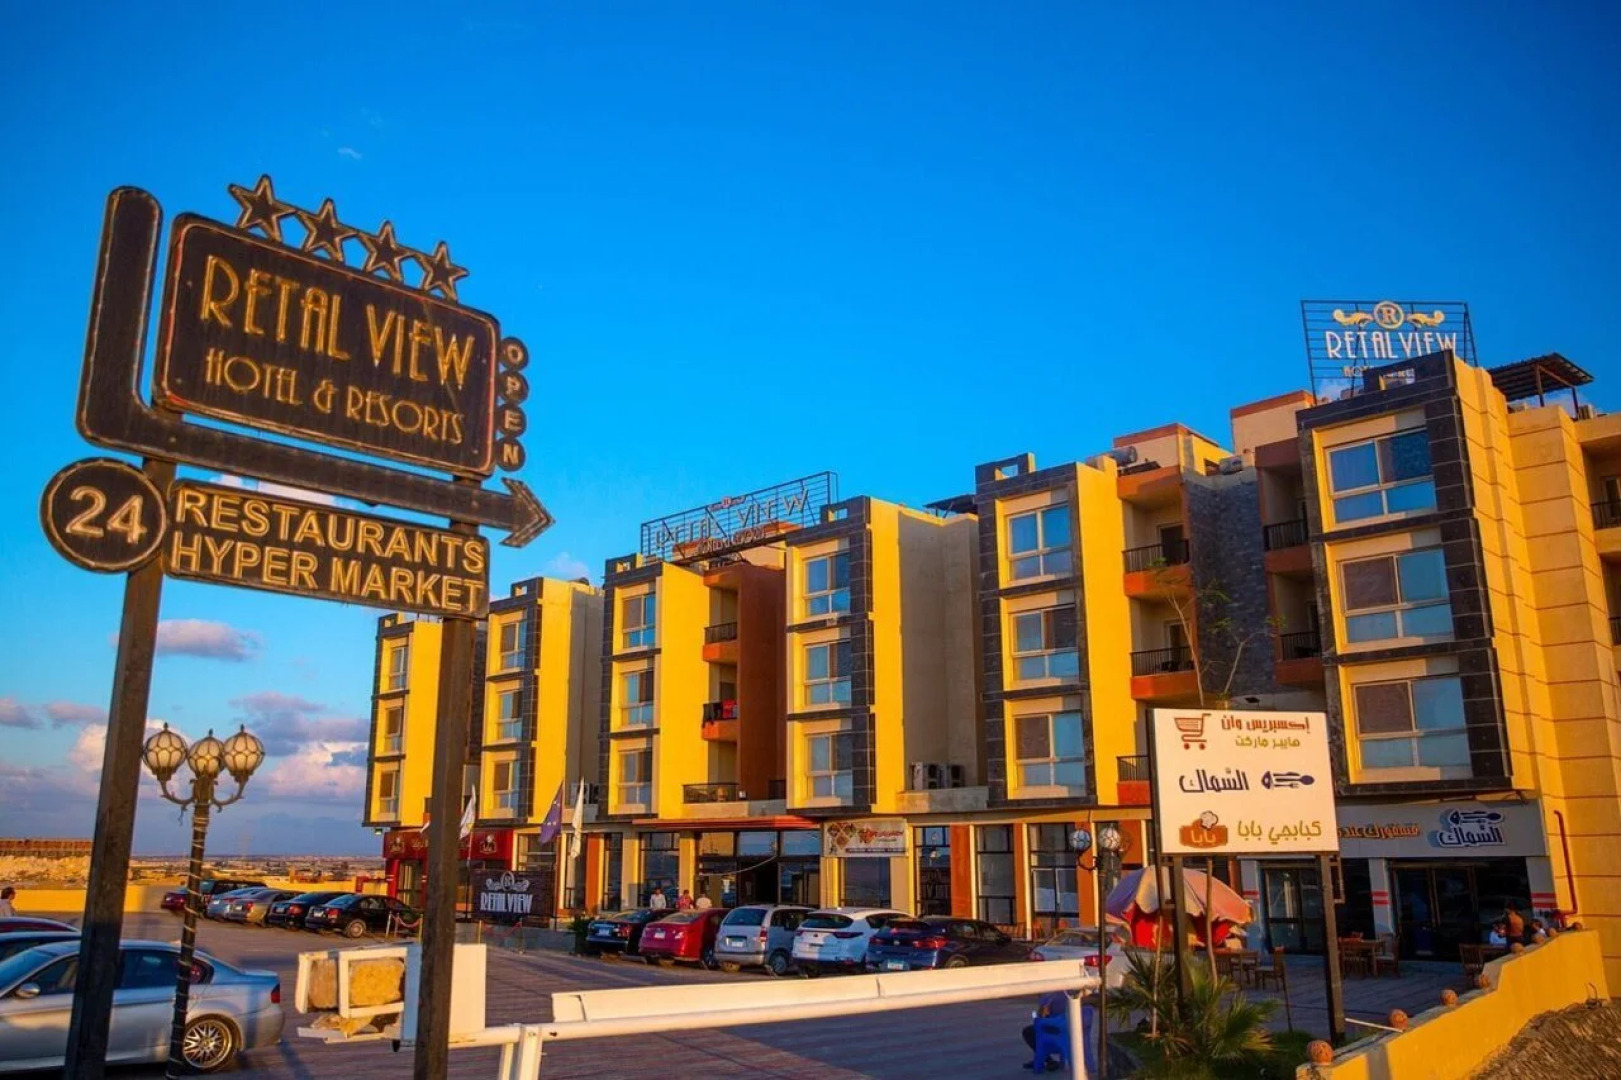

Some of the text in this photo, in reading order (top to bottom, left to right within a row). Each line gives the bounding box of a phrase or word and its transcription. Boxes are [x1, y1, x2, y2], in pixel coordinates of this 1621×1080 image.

[199, 254, 476, 391] RETAL VIEW
[1325, 330, 1457, 359] RETAL VIEW
[206, 347, 465, 446] HOTEL & RESORTS
[64, 485, 148, 545] 24
[175, 487, 486, 574] RESTAURANTS
[171, 529, 486, 615] HYPER MARKET
[1237, 819, 1323, 845] كبابجي بابا
[507, 893, 534, 914] VIEW
